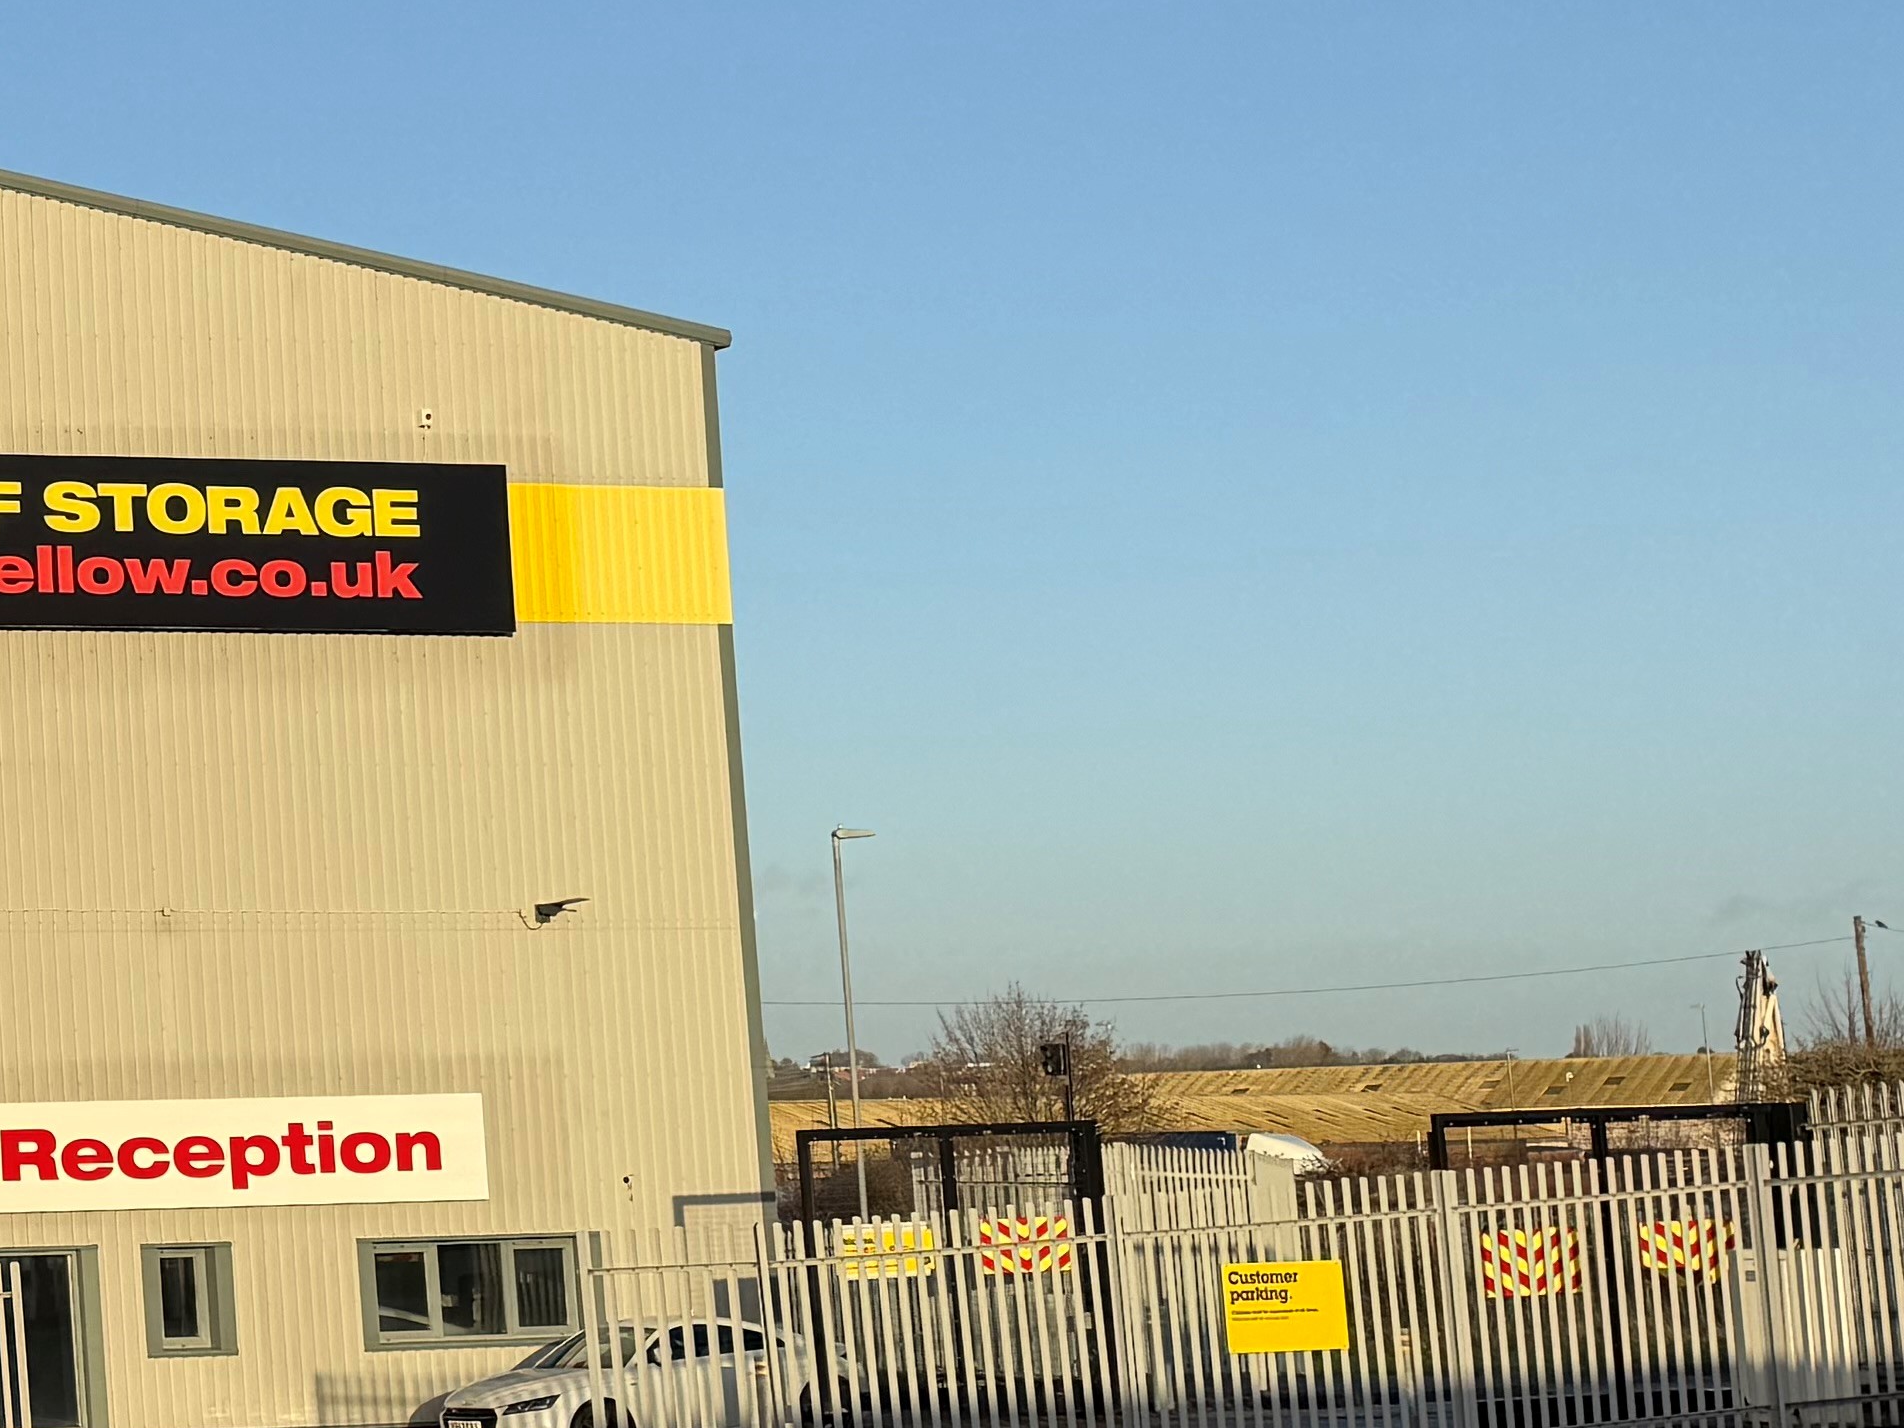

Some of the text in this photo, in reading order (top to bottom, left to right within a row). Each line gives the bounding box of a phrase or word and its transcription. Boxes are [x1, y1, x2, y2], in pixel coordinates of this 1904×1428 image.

[43, 481, 421, 538] STORAGE
[0, 1120, 443, 1190] Reception
[1228, 1271, 1298, 1285] Customer
[1230, 1287, 1293, 1305] parking.
